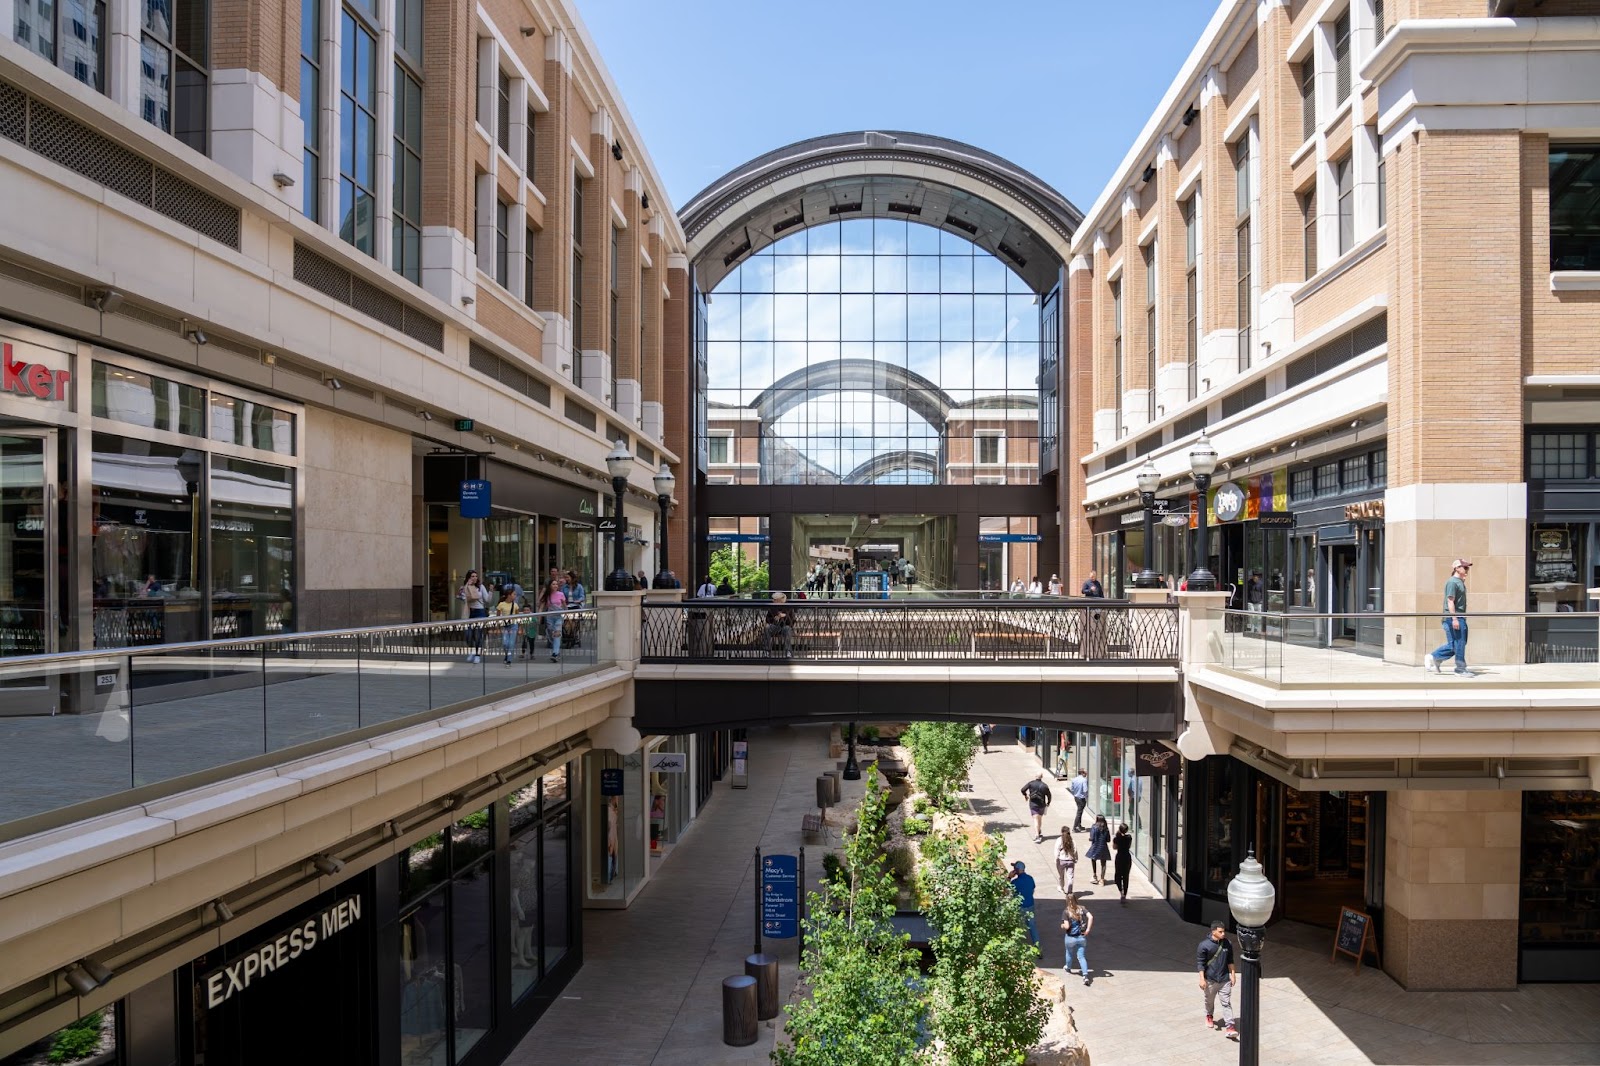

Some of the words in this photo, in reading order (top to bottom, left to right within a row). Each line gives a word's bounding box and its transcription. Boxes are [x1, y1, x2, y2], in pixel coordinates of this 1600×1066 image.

[3, 343, 70, 401] ker
[460, 420, 472, 430] EXIT
[579, 498, 595, 516] Clarks
[207, 920, 318, 1010] EXPRESS
[321, 894, 361, 942] MEN
